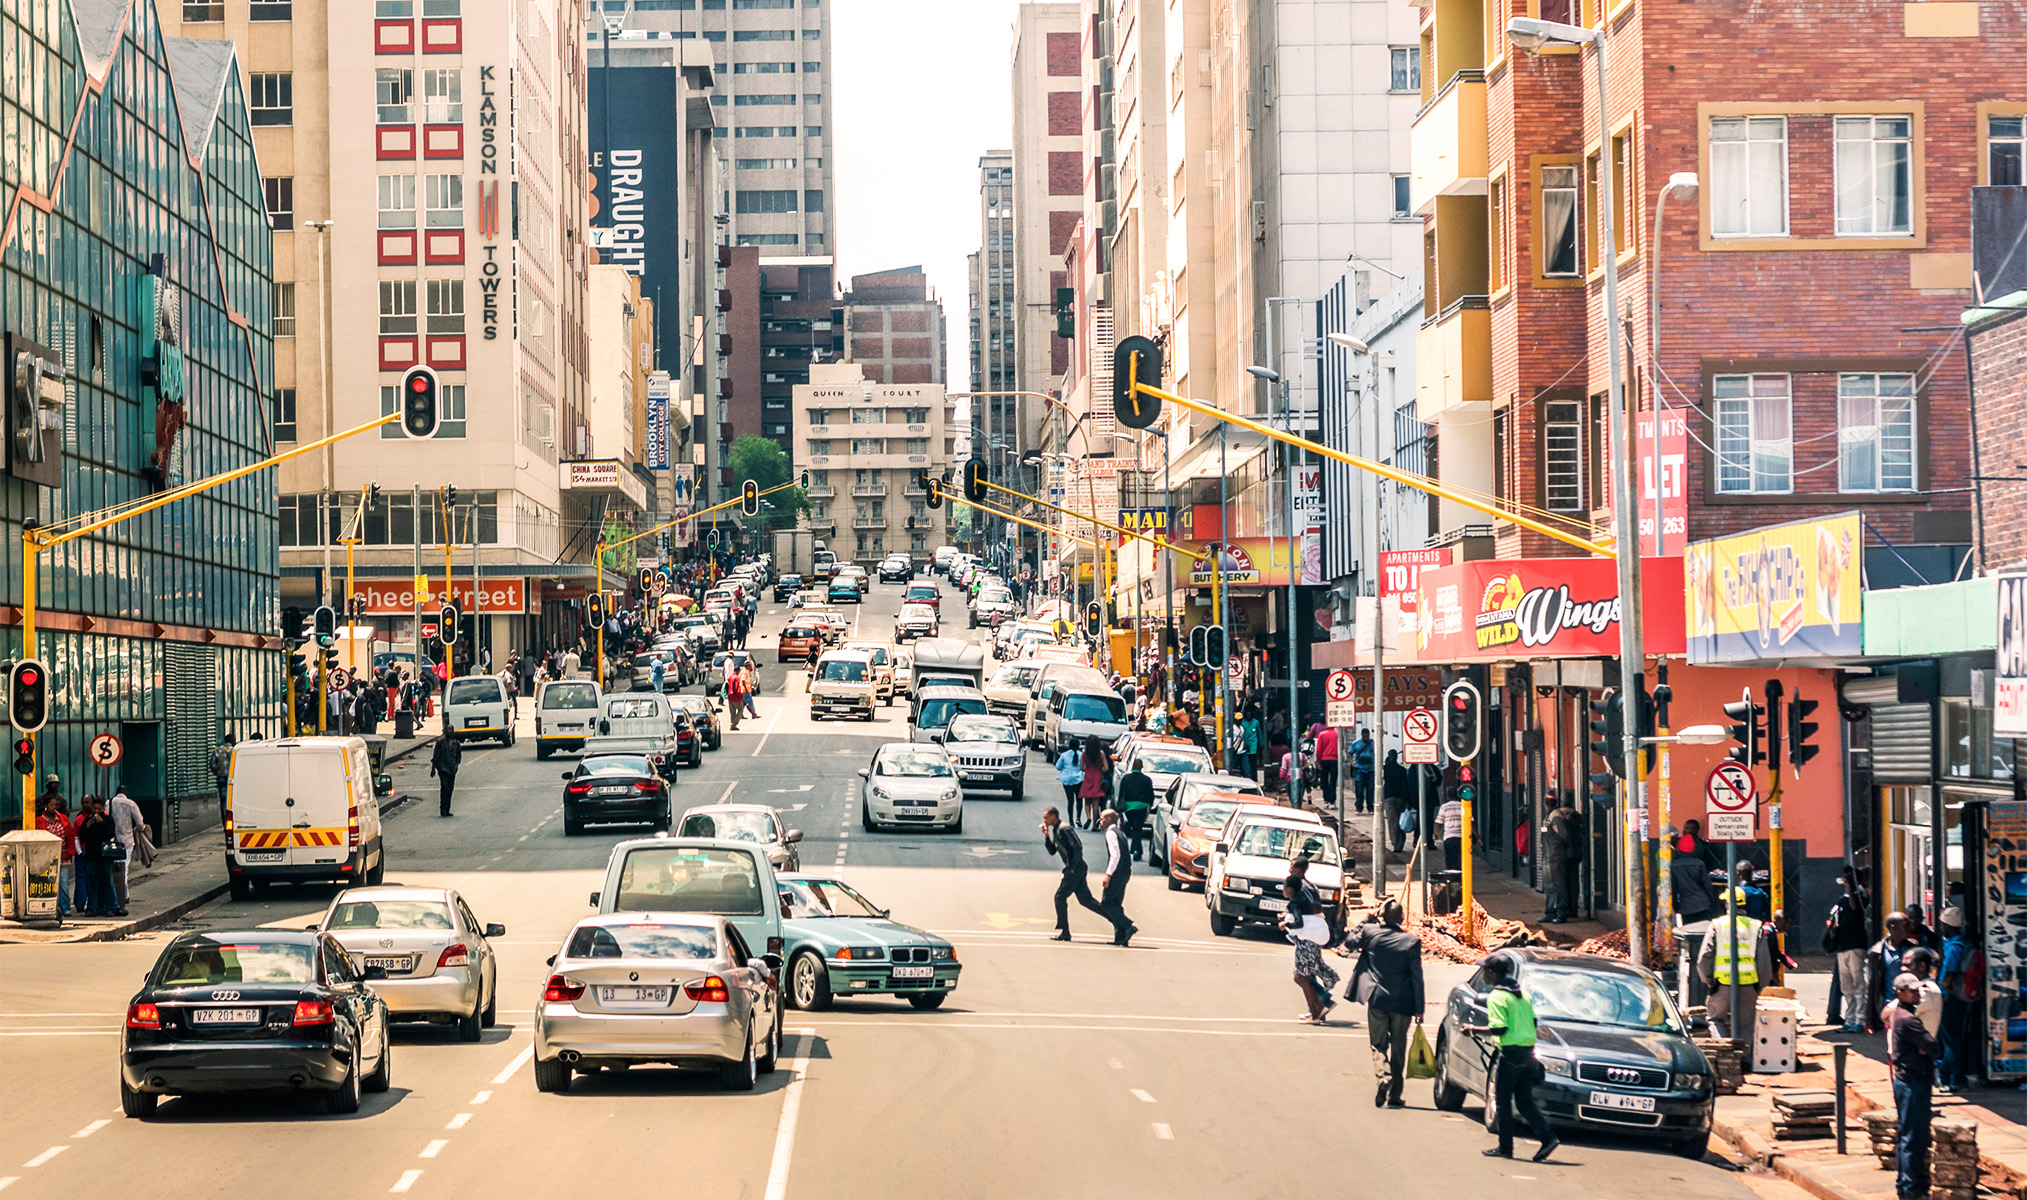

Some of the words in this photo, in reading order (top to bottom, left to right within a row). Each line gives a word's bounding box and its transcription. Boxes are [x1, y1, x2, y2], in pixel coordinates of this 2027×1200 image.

[480, 65, 497, 174] KLAMSON
[610, 149, 645, 276] DRAUGHT
[479, 245, 501, 340] TOWERS
[648, 400, 658, 468] BROOKLYN
[572, 465, 591, 474] CHINA
[593, 464, 618, 473] SQUARE
[572, 475, 586, 483] 154
[1386, 550, 1441, 564] APARTMENTS
[1194, 572, 1251, 583] BUTHERY
[1386, 565, 1408, 591] TO
[1515, 584, 1621, 647] Wings
[1476, 622, 1519, 649] WILD
[1355, 675, 1429, 693] GAYS
[1394, 695, 1438, 705] SPOT
[401, 959, 411, 969] GP
[604, 989, 615, 1000] 13
[636, 989, 647, 1000] 13
[654, 989, 666, 1000] GP
[197, 1010, 213, 1021] VZK
[217, 1010, 234, 1021] 201
[246, 1010, 257, 1020] GP
